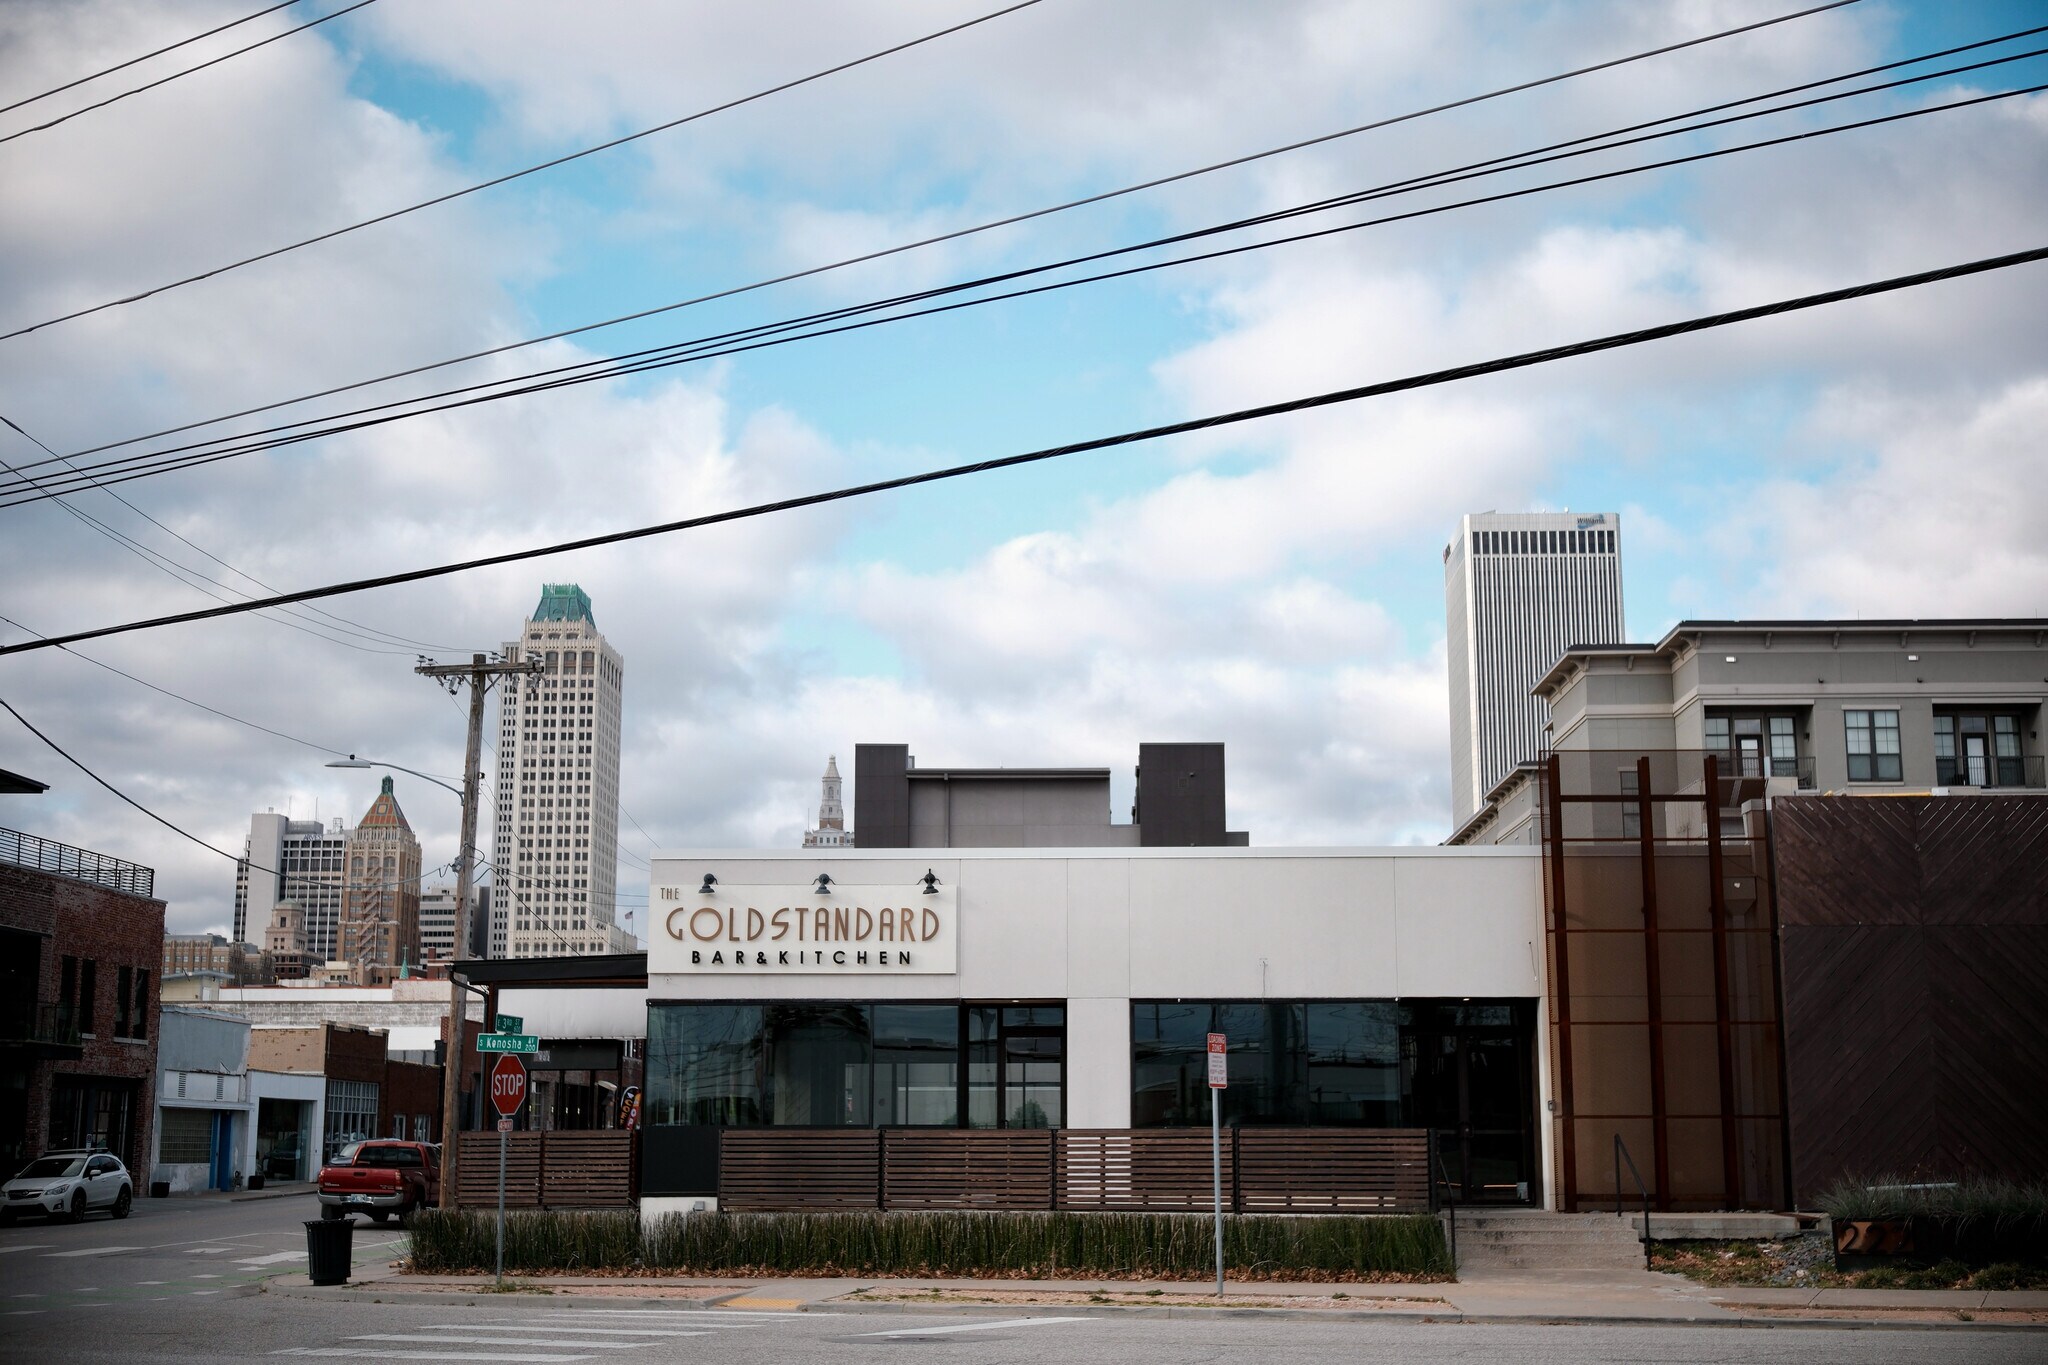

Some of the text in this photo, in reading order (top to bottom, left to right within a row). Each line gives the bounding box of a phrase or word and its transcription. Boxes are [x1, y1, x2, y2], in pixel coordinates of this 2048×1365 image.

[660, 887, 680, 899] THE
[502, 1018, 513, 1029] 3RD
[486, 1037, 522, 1050] Kenosha
[1209, 1035, 1225, 1043] LOADING
[525, 1044, 536, 1052] 200
[1211, 1044, 1223, 1052] ZONE
[494, 1074, 524, 1096] STOP
